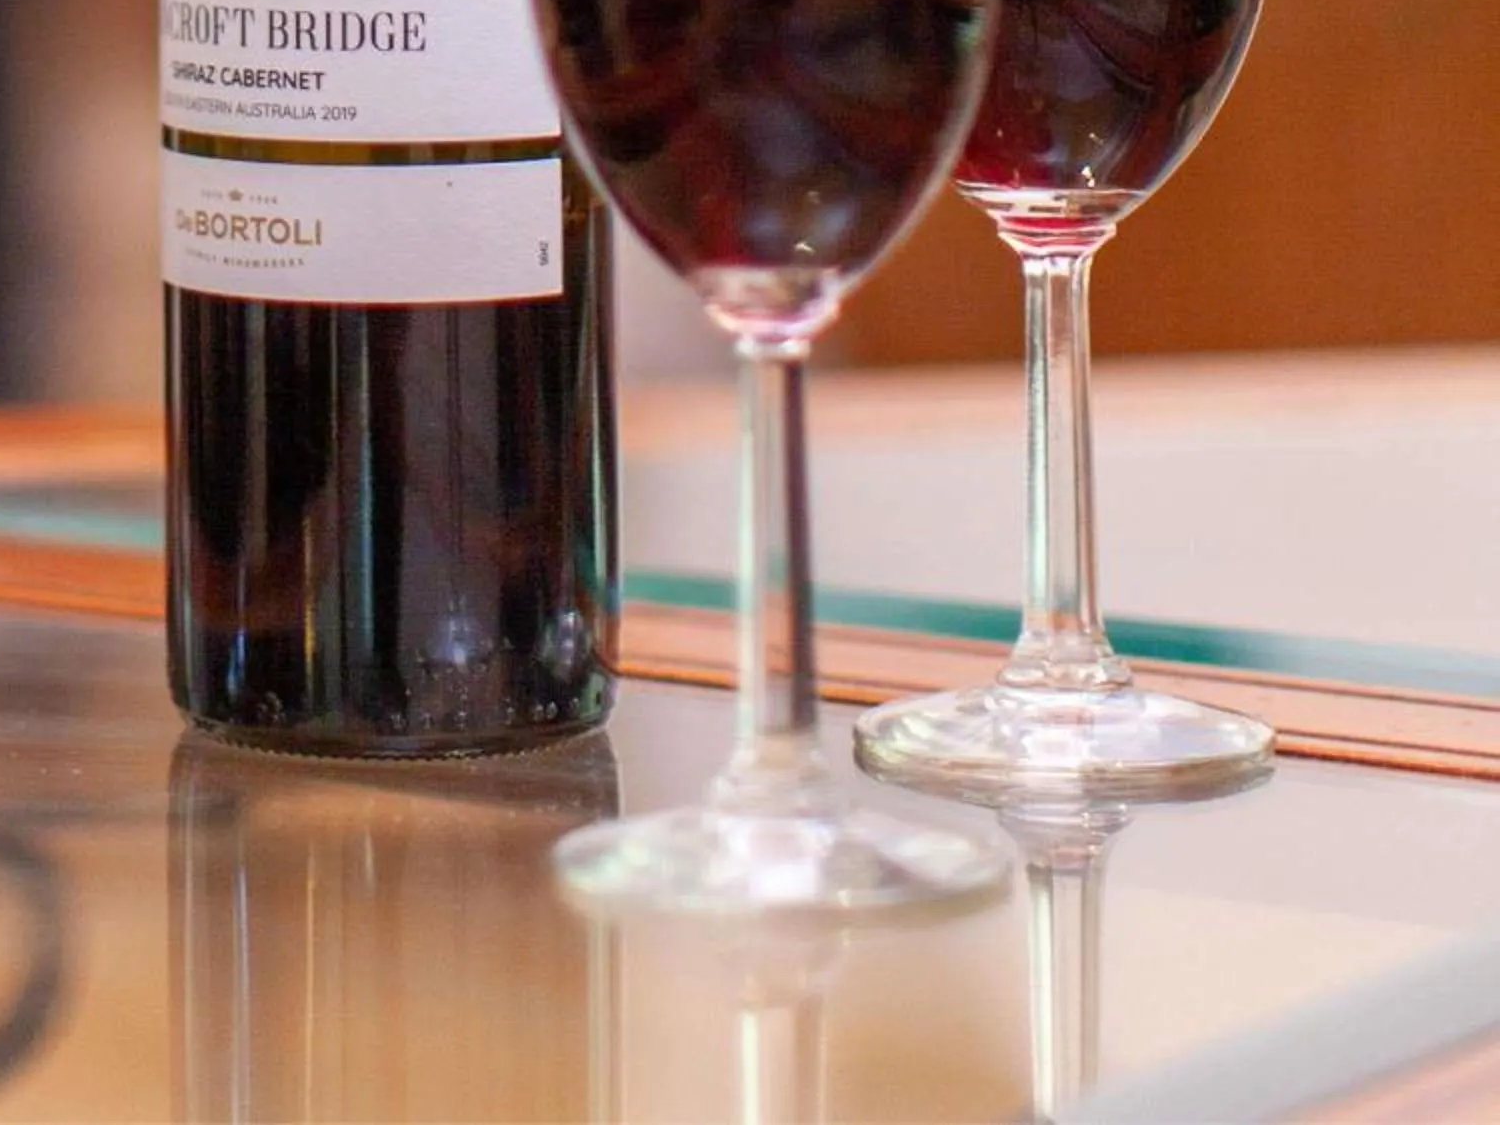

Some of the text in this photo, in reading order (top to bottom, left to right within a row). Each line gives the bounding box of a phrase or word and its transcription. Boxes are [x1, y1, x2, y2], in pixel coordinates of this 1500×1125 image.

[267, 10, 426, 52] BRIDGE
[220, 66, 325, 90] CABERNET
[235, 101, 316, 120] AUSTRALIA
[321, 105, 357, 121] 2019
